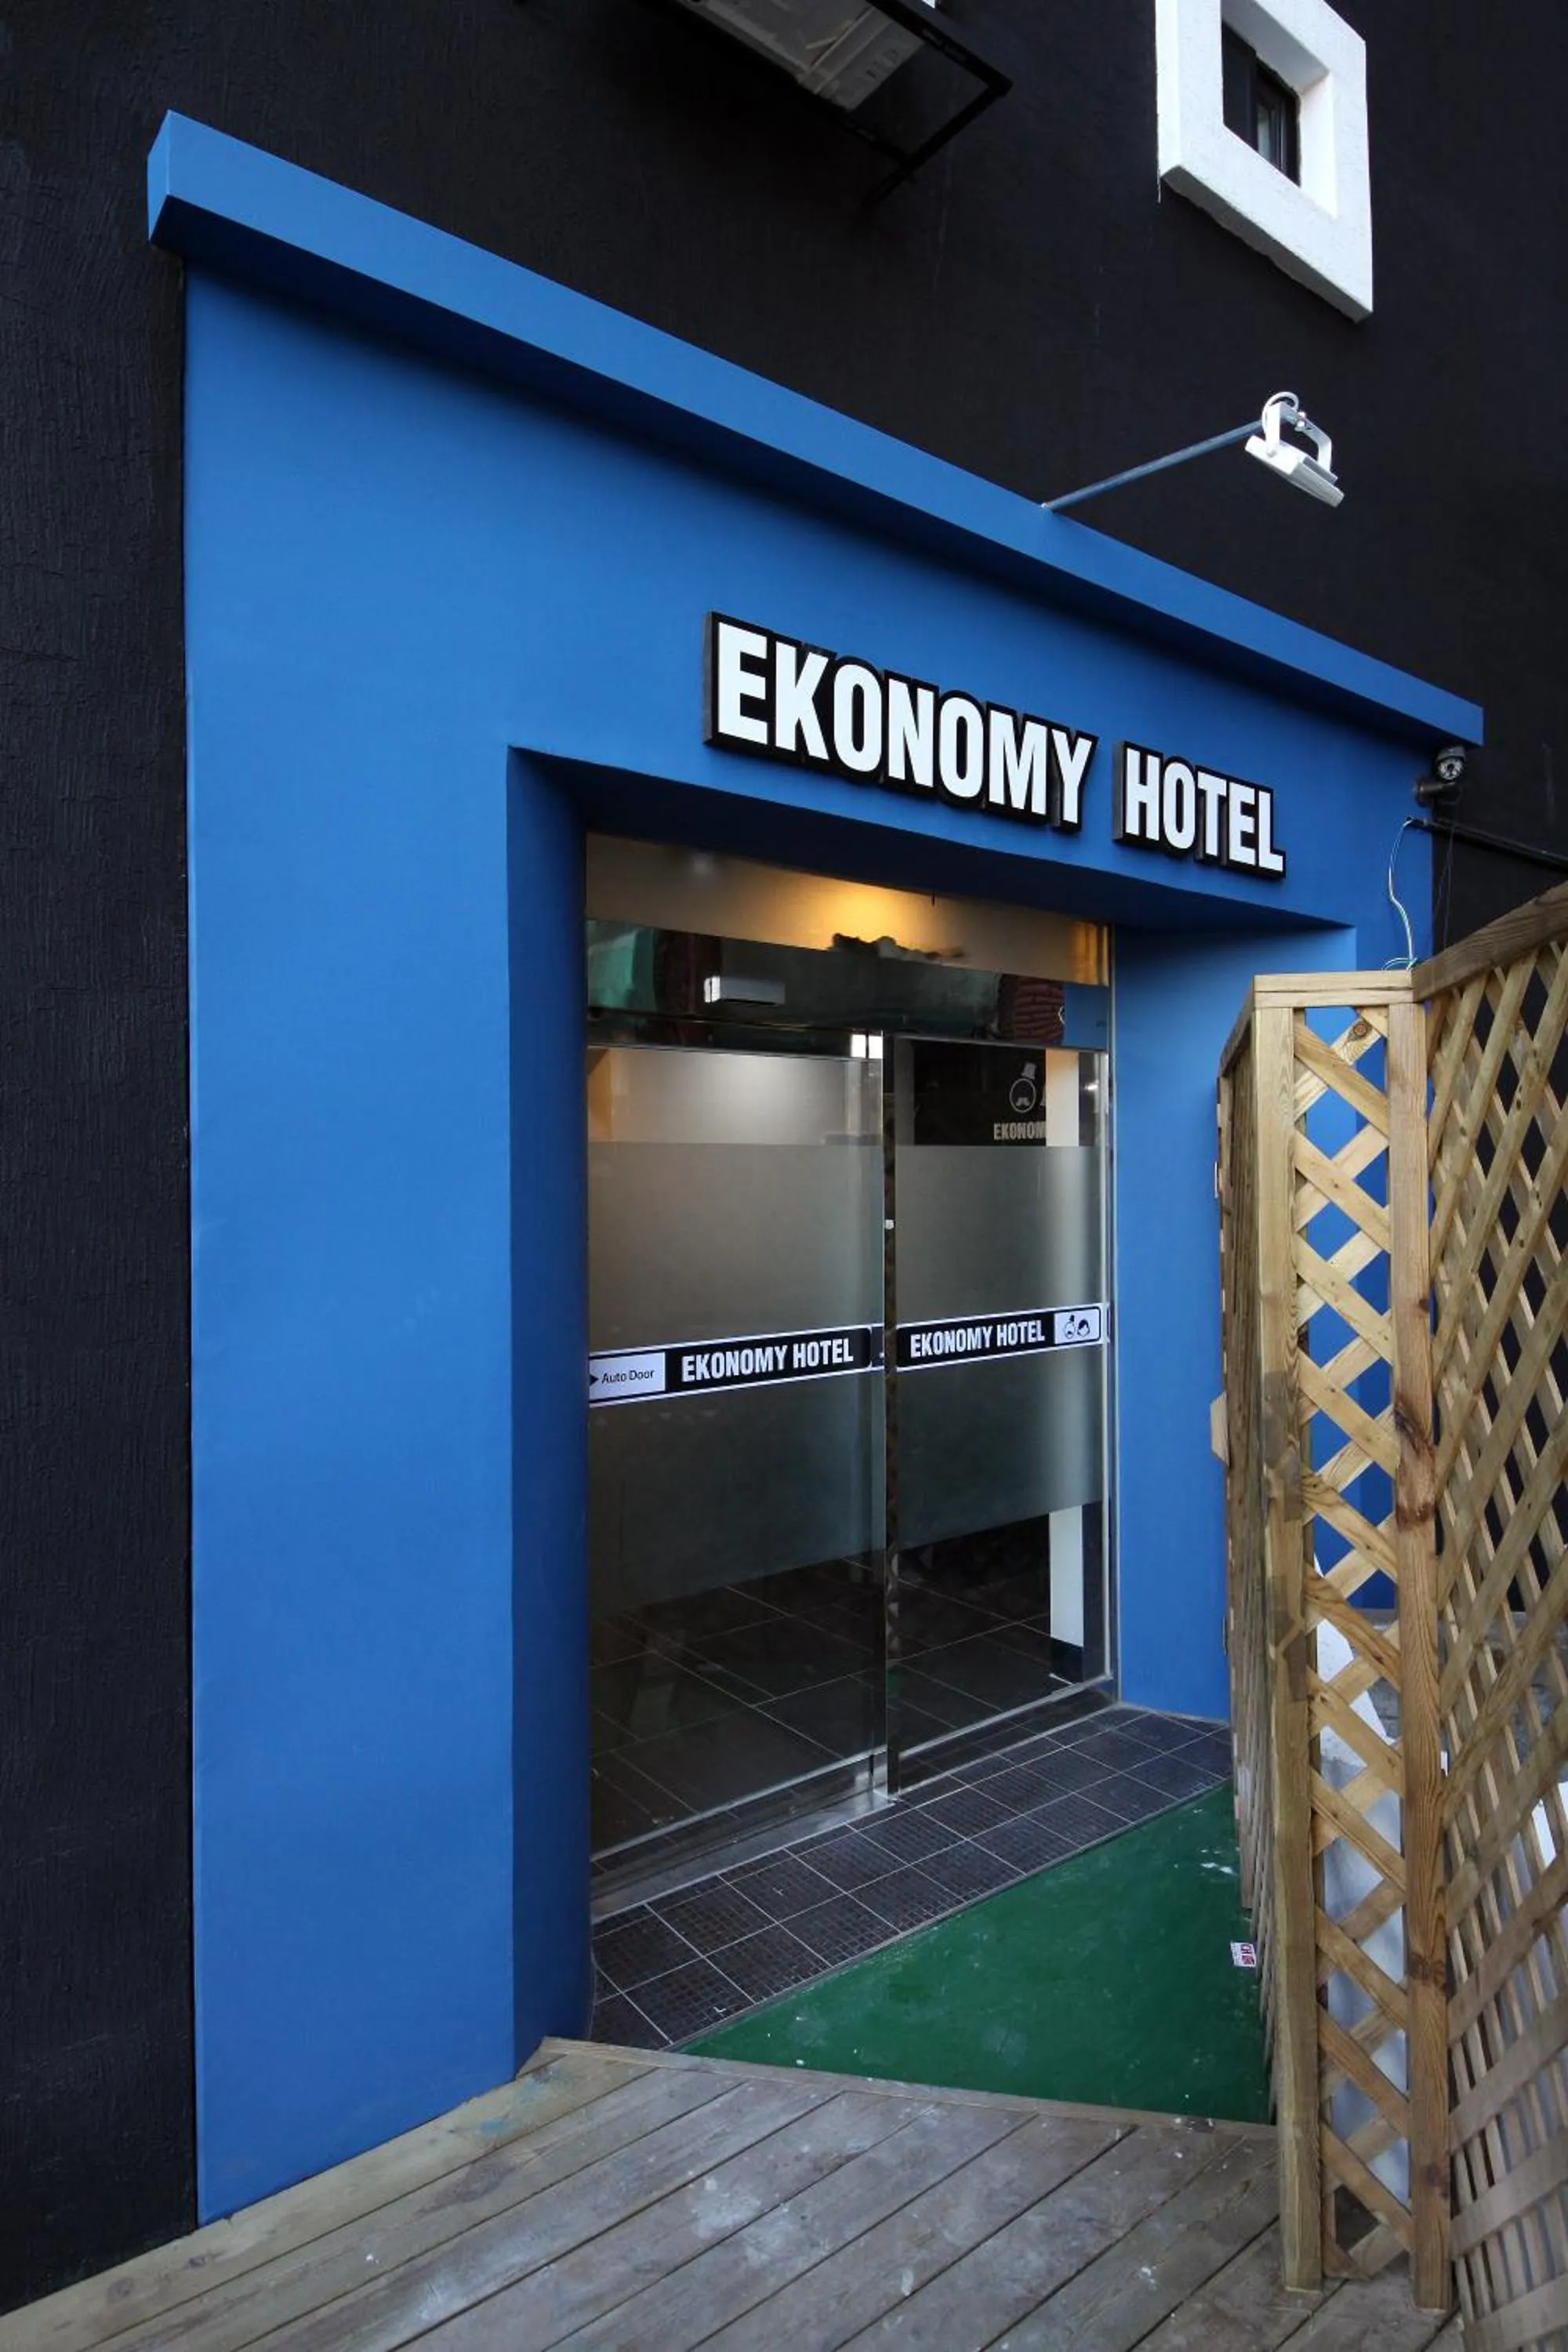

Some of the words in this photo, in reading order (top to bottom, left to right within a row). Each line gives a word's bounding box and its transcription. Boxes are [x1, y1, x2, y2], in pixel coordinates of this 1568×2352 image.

[718, 622, 1093, 824] EKONOMY
[1126, 749, 1284, 872] HOTEL
[910, 1327, 993, 1358] EKONOMY
[996, 1320, 1045, 1346] HOTEL
[601, 1372, 627, 1384] Auto
[629, 1370, 655, 1381] Door
[681, 1345, 788, 1382] EKONOMY
[793, 1338, 854, 1368] HOTEL
